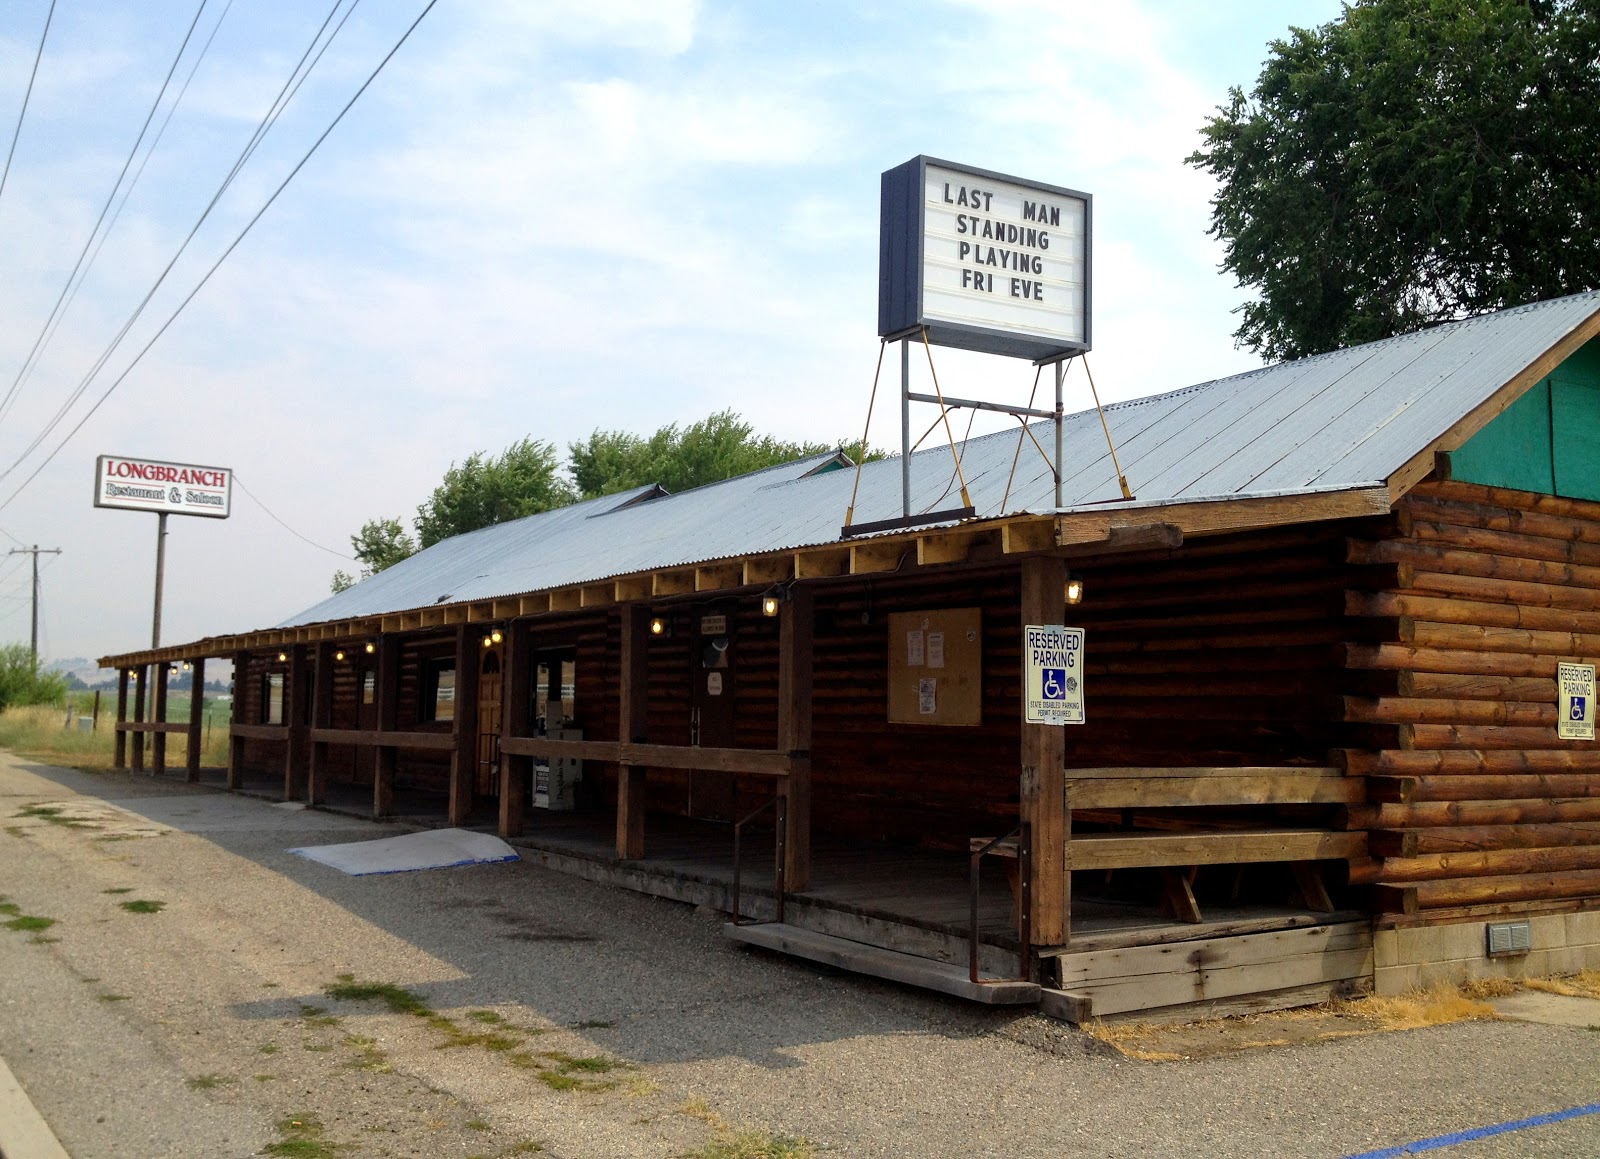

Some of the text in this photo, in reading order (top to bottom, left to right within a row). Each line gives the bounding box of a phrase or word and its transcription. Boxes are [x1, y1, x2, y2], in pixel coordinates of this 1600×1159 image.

[944, 183, 1060, 227] LAST MAN
[957, 213, 1049, 250] STANDING
[959, 241, 1043, 275] PLAYING
[962, 268, 1043, 301] FRI EVE
[107, 460, 226, 487] LONGBRANCH
[106, 482, 224, 506] Restaurant & Saloon
[1029, 631, 1080, 651] RESERVED
[1033, 650, 1075, 668] PARKING
[1560, 667, 1592, 683] RESERVED
[1563, 682, 1591, 696] PARKING
[1062, 701, 1080, 710] PARKING
